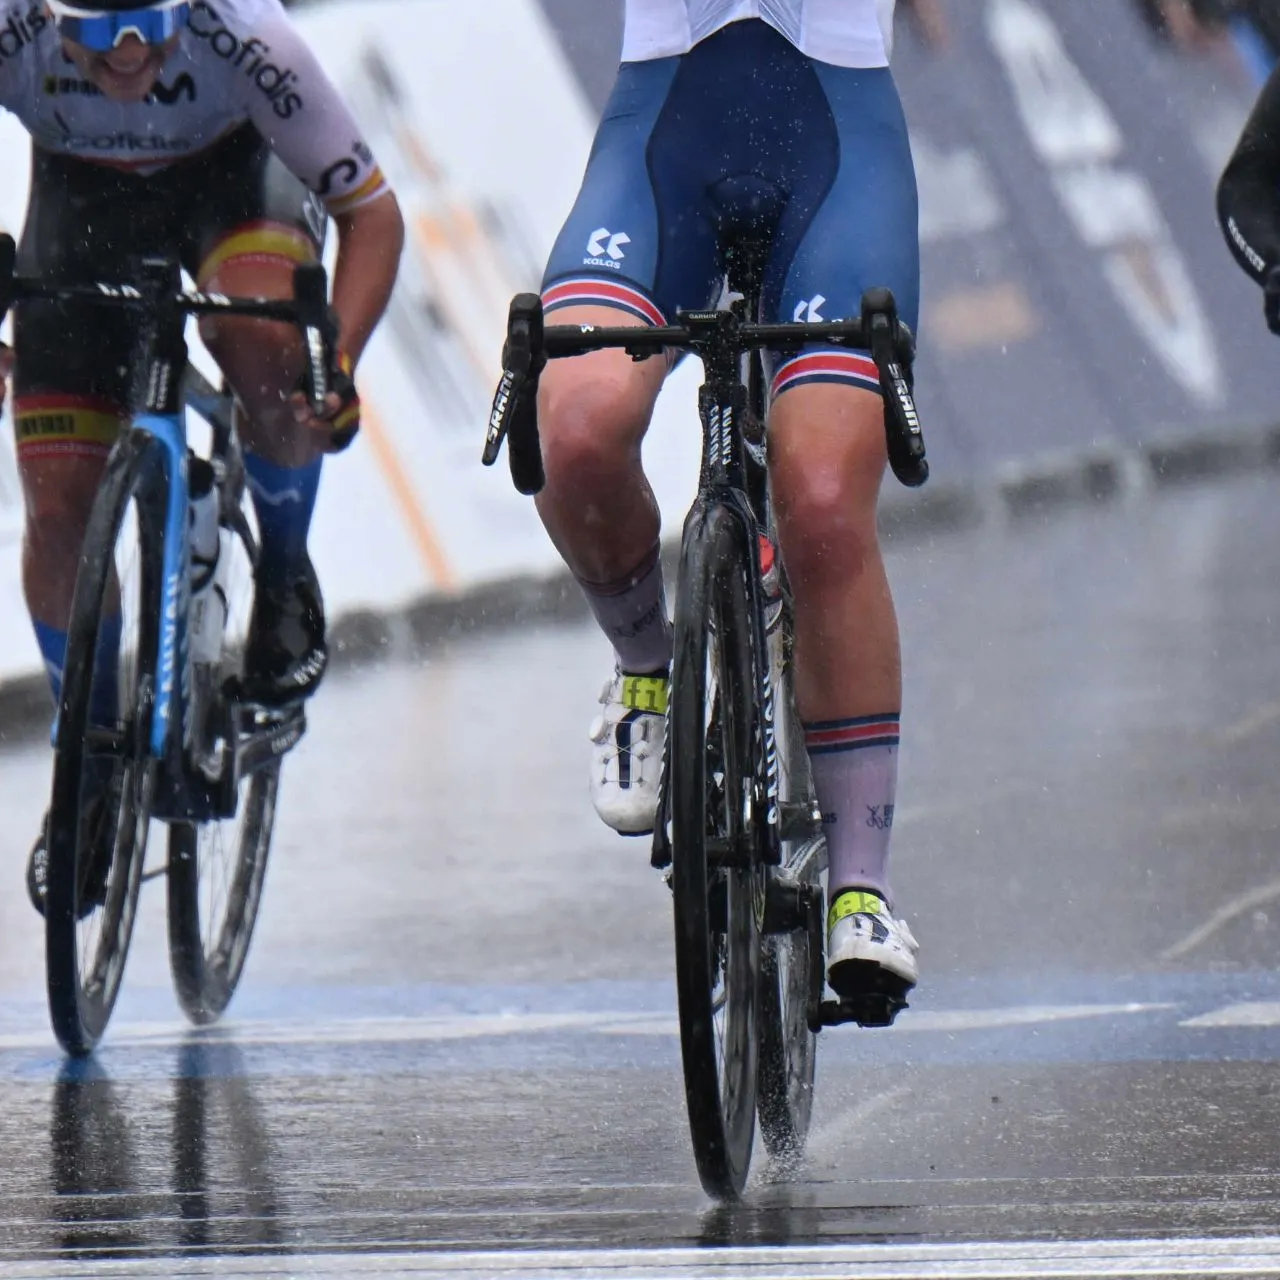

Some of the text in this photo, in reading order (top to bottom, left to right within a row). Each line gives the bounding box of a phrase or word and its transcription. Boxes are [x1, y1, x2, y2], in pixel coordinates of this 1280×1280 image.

[187, 1, 303, 120] Cofidis
[688, 312, 718, 320] GARMIN
[487, 369, 515, 445] SRAM
[888, 363, 921, 434] SRAM
